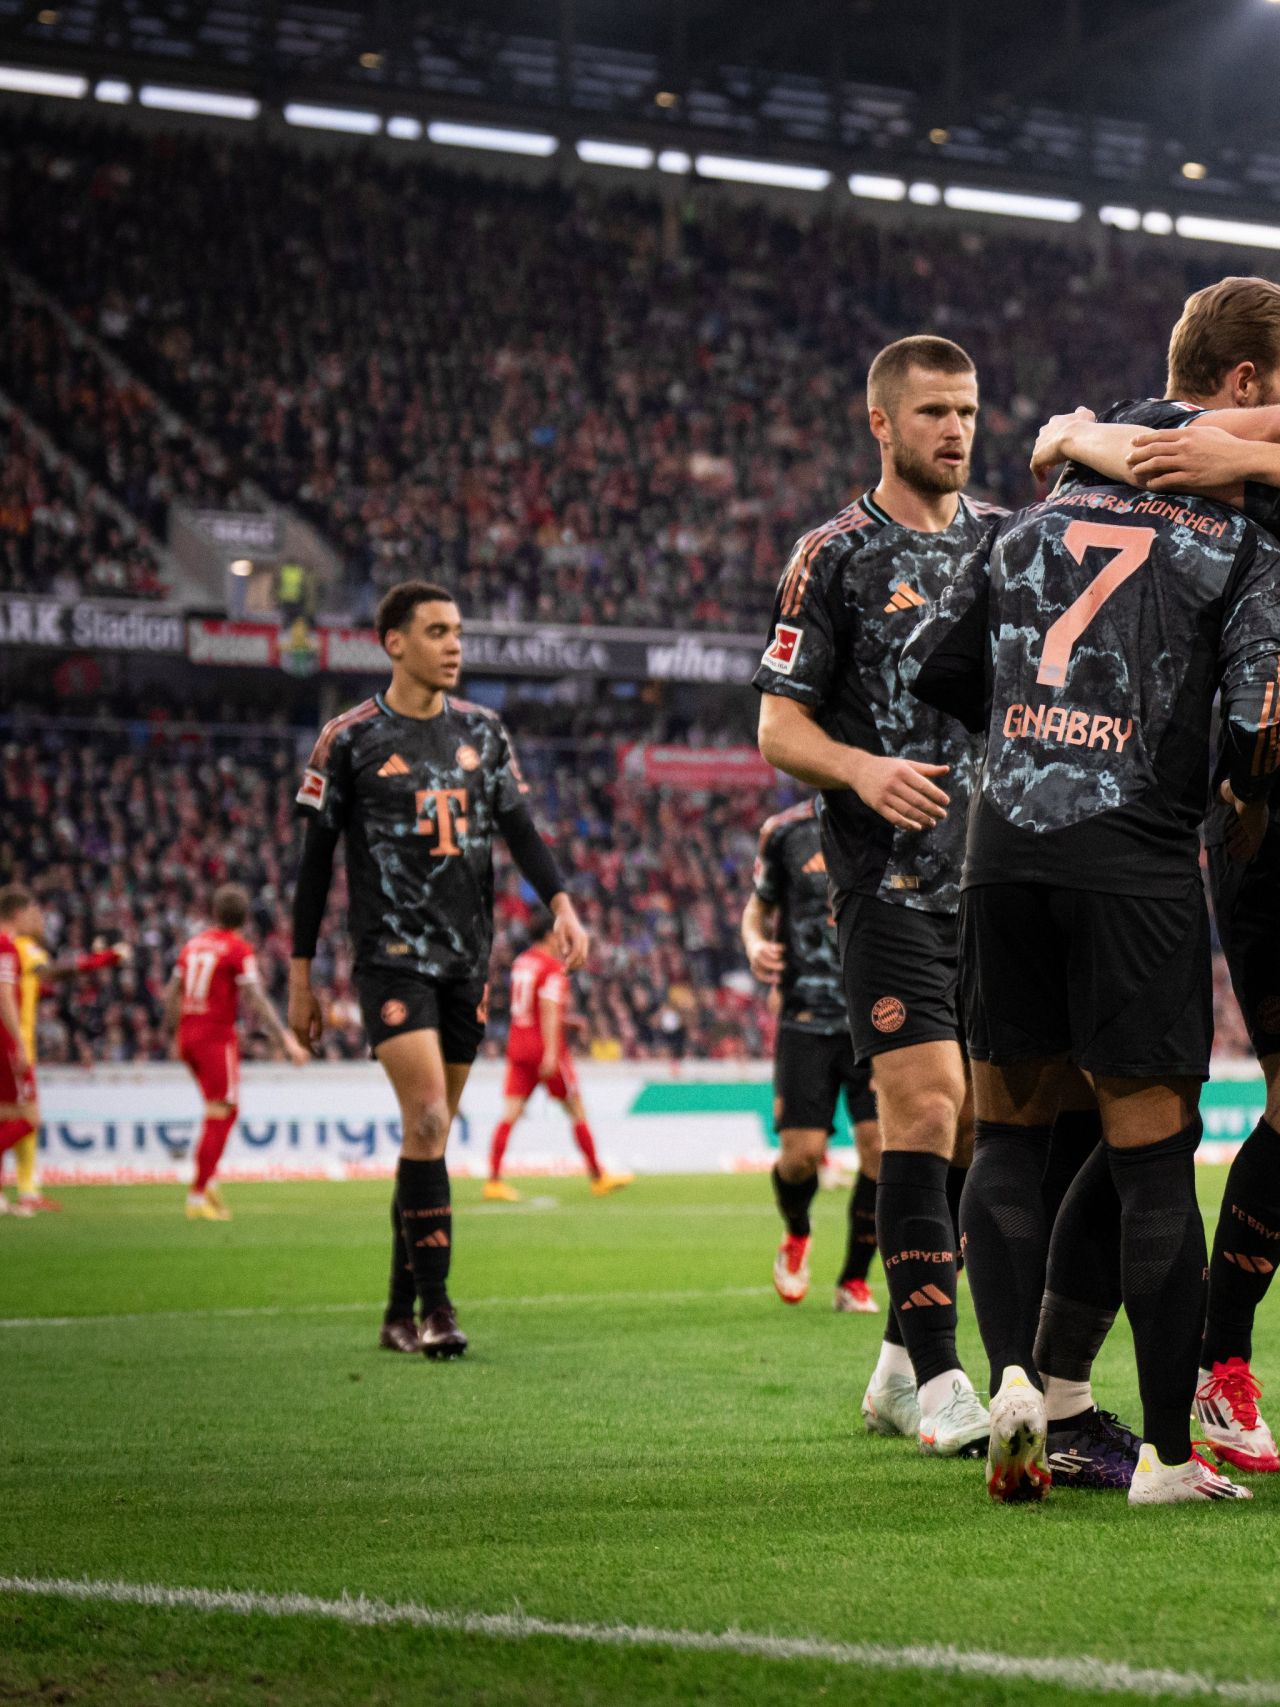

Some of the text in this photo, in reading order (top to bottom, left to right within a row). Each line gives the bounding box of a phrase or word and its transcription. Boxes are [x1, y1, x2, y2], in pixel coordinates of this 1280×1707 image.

[1133, 500, 1229, 538] MÜNCHEN
[1036, 519, 1157, 688] 7
[1002, 703, 1133, 752] GNABRY
[886, 1250, 953, 1269] FC BAYERN
